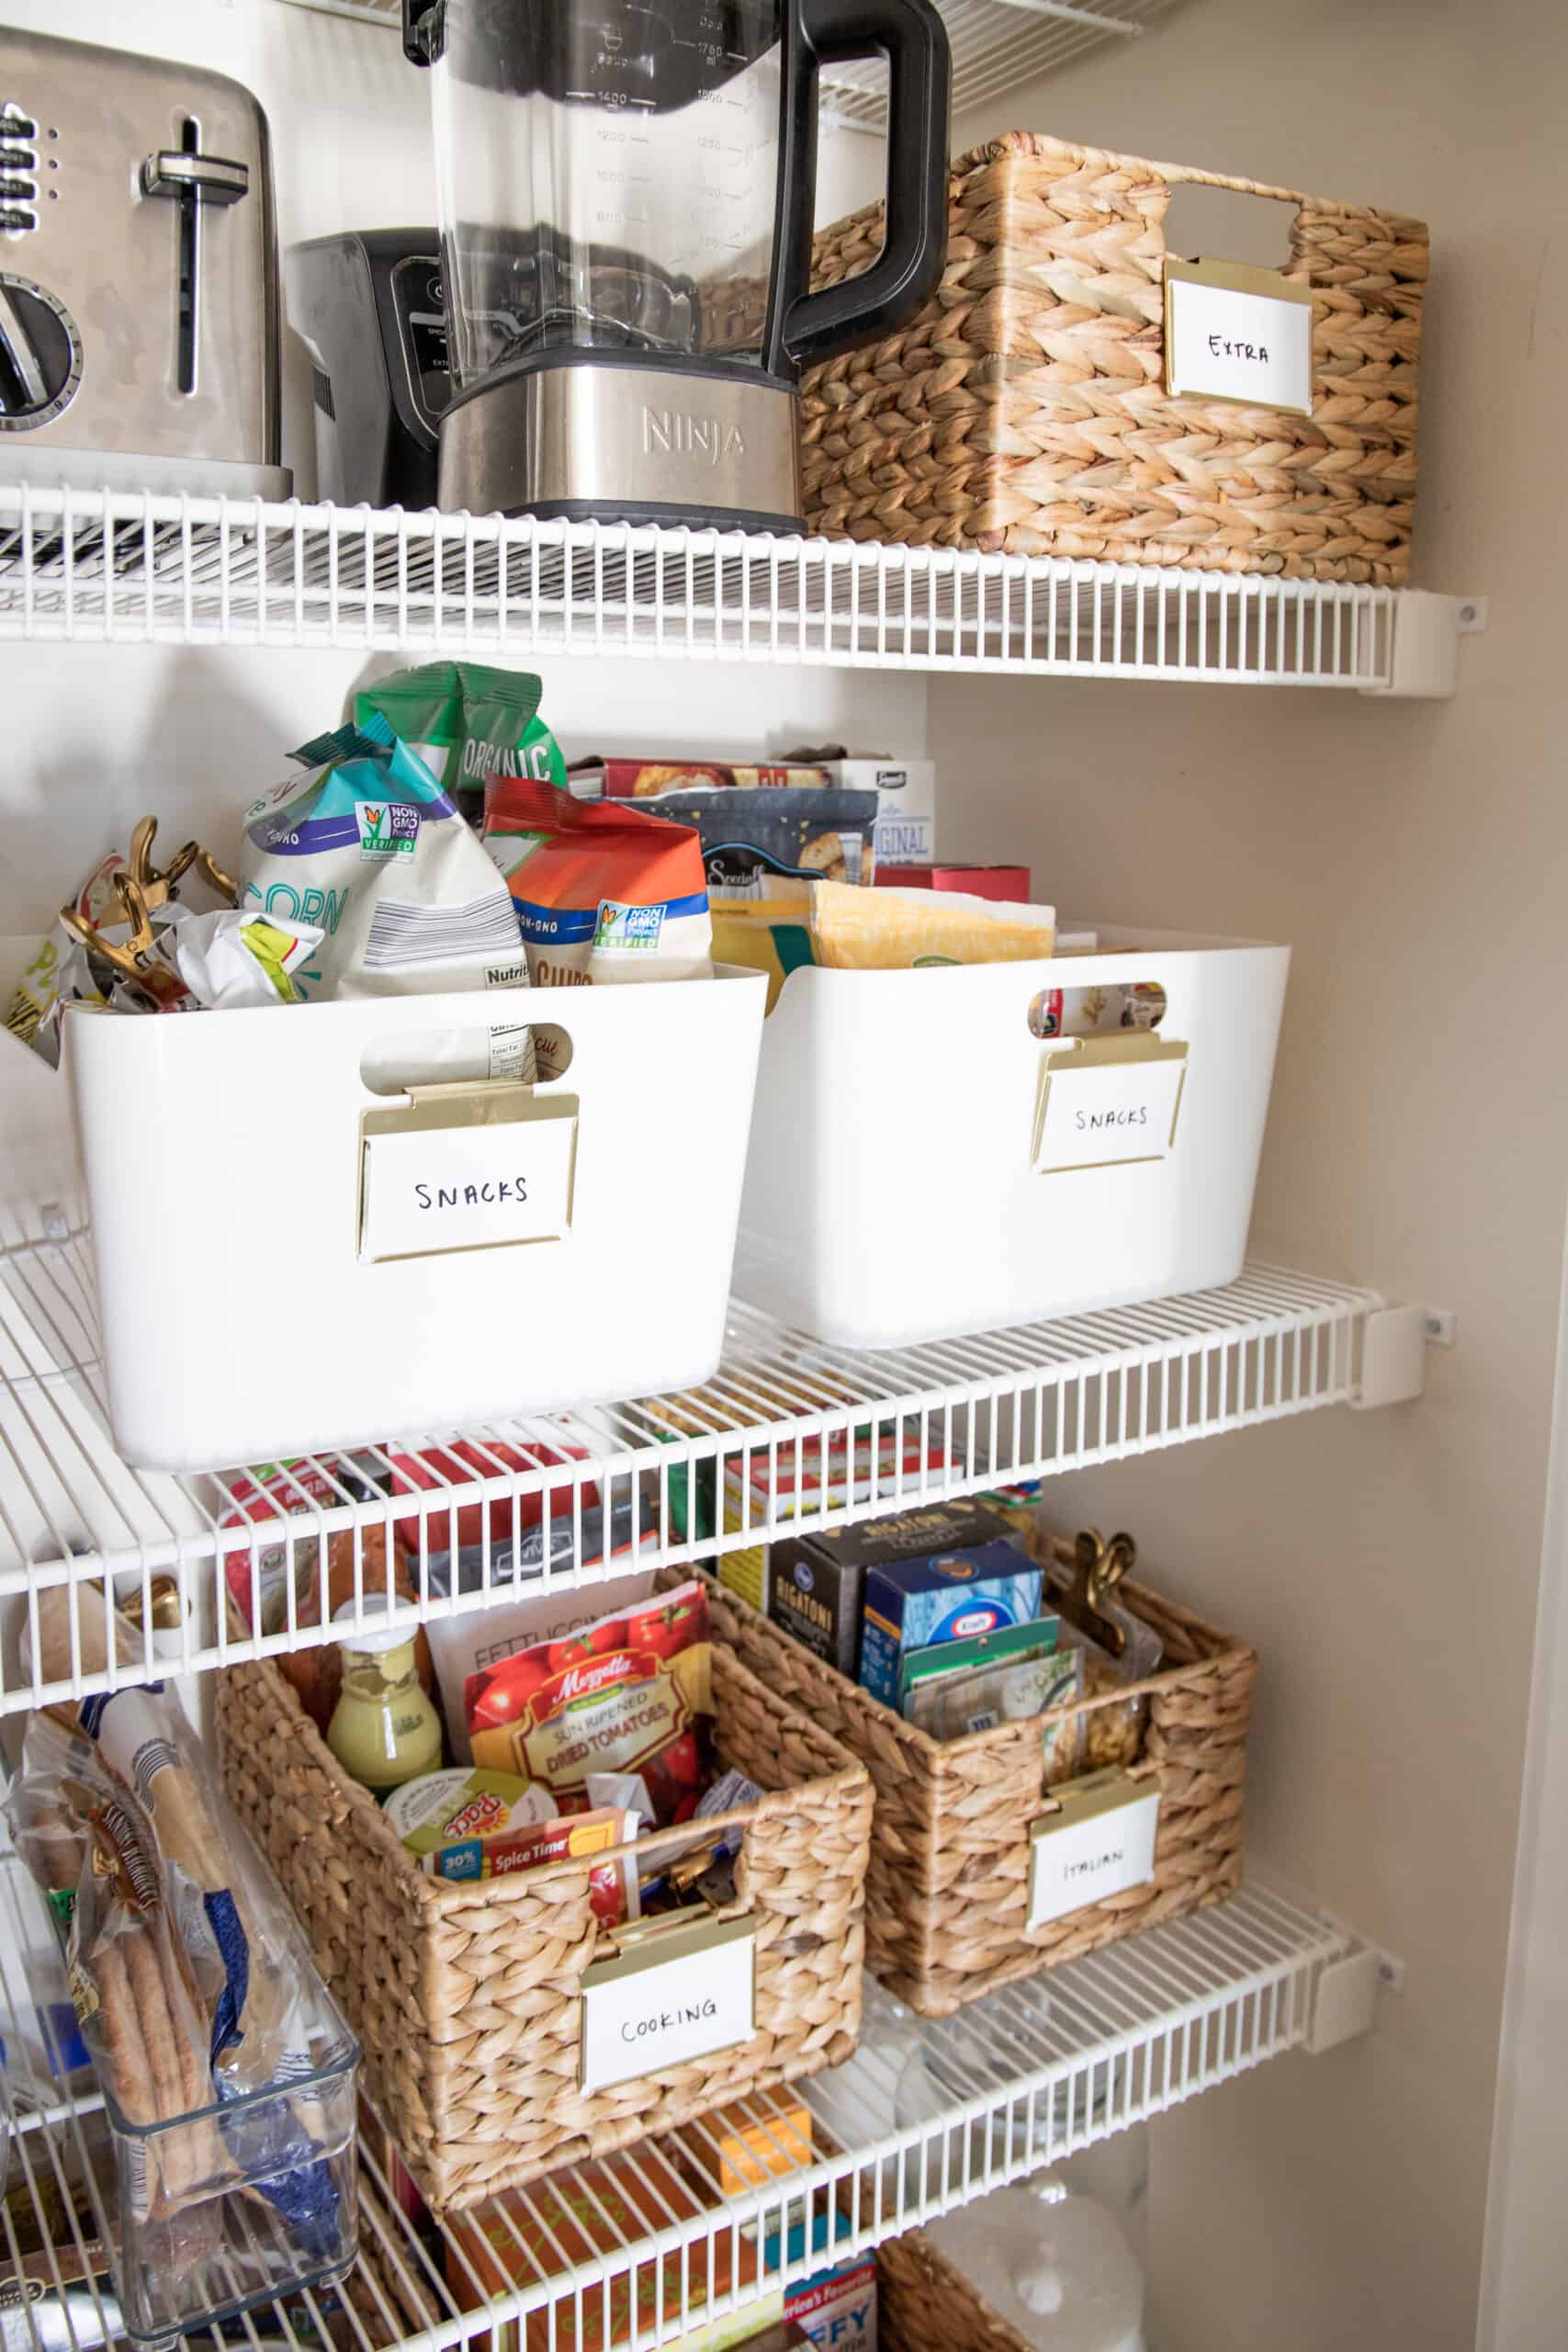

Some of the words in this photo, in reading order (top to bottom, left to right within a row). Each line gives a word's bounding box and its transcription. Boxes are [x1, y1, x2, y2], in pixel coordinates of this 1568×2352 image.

[1209, 334, 1269, 364] EXTRA
[643, 405, 746, 466] NINJA
[464, 738, 551, 781] ORGANIC
[392, 807, 418, 819] NON
[392, 818, 418, 829] GMO
[367, 838, 412, 852] VERIFIED
[248, 881, 348, 935] ORN
[628, 918, 660, 928] GMO
[631, 908, 660, 918] NON
[1076, 1107, 1147, 1130] SNACKS
[415, 1177, 527, 1209] SNACKS
[553, 1656, 632, 1703] Mezzetta
[553, 1722, 583, 1744] SUN
[585, 1691, 648, 1728] RIPENED
[546, 1742, 590, 1773] DRIED
[588, 1702, 671, 1751] TOMATOES
[496, 1850, 530, 1871] Spice
[622, 1999, 716, 2041] COOKING
[807, 2301, 870, 2345] FFY
